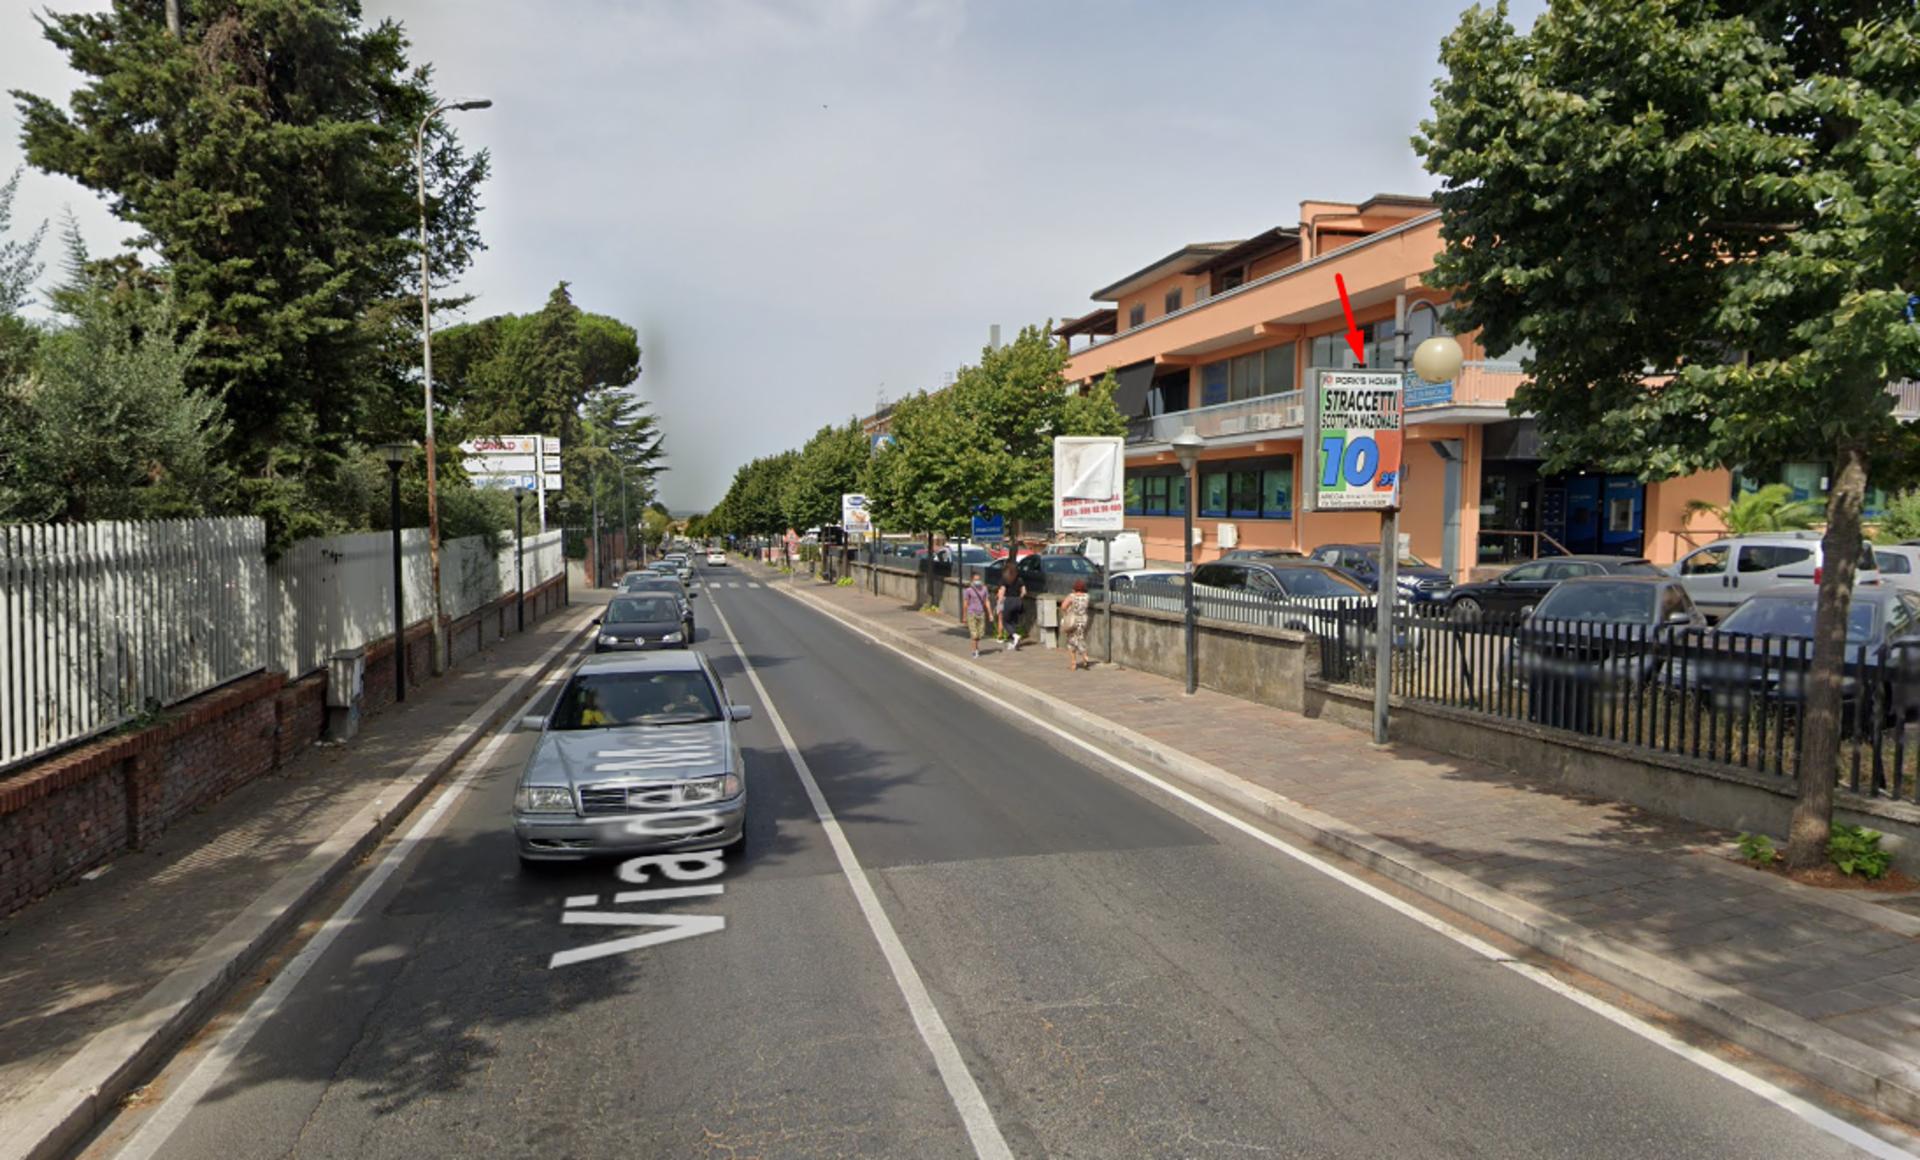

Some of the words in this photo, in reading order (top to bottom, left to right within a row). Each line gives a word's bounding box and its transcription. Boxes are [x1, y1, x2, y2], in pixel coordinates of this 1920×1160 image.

[1335, 376, 1367, 385] PORK'S
[1368, 376, 1398, 385] HOUSE
[1325, 390, 1398, 411] STRACCETTI
[1322, 413, 1358, 429] SCOTTONA
[1360, 413, 1400, 429] NAZIONALE
